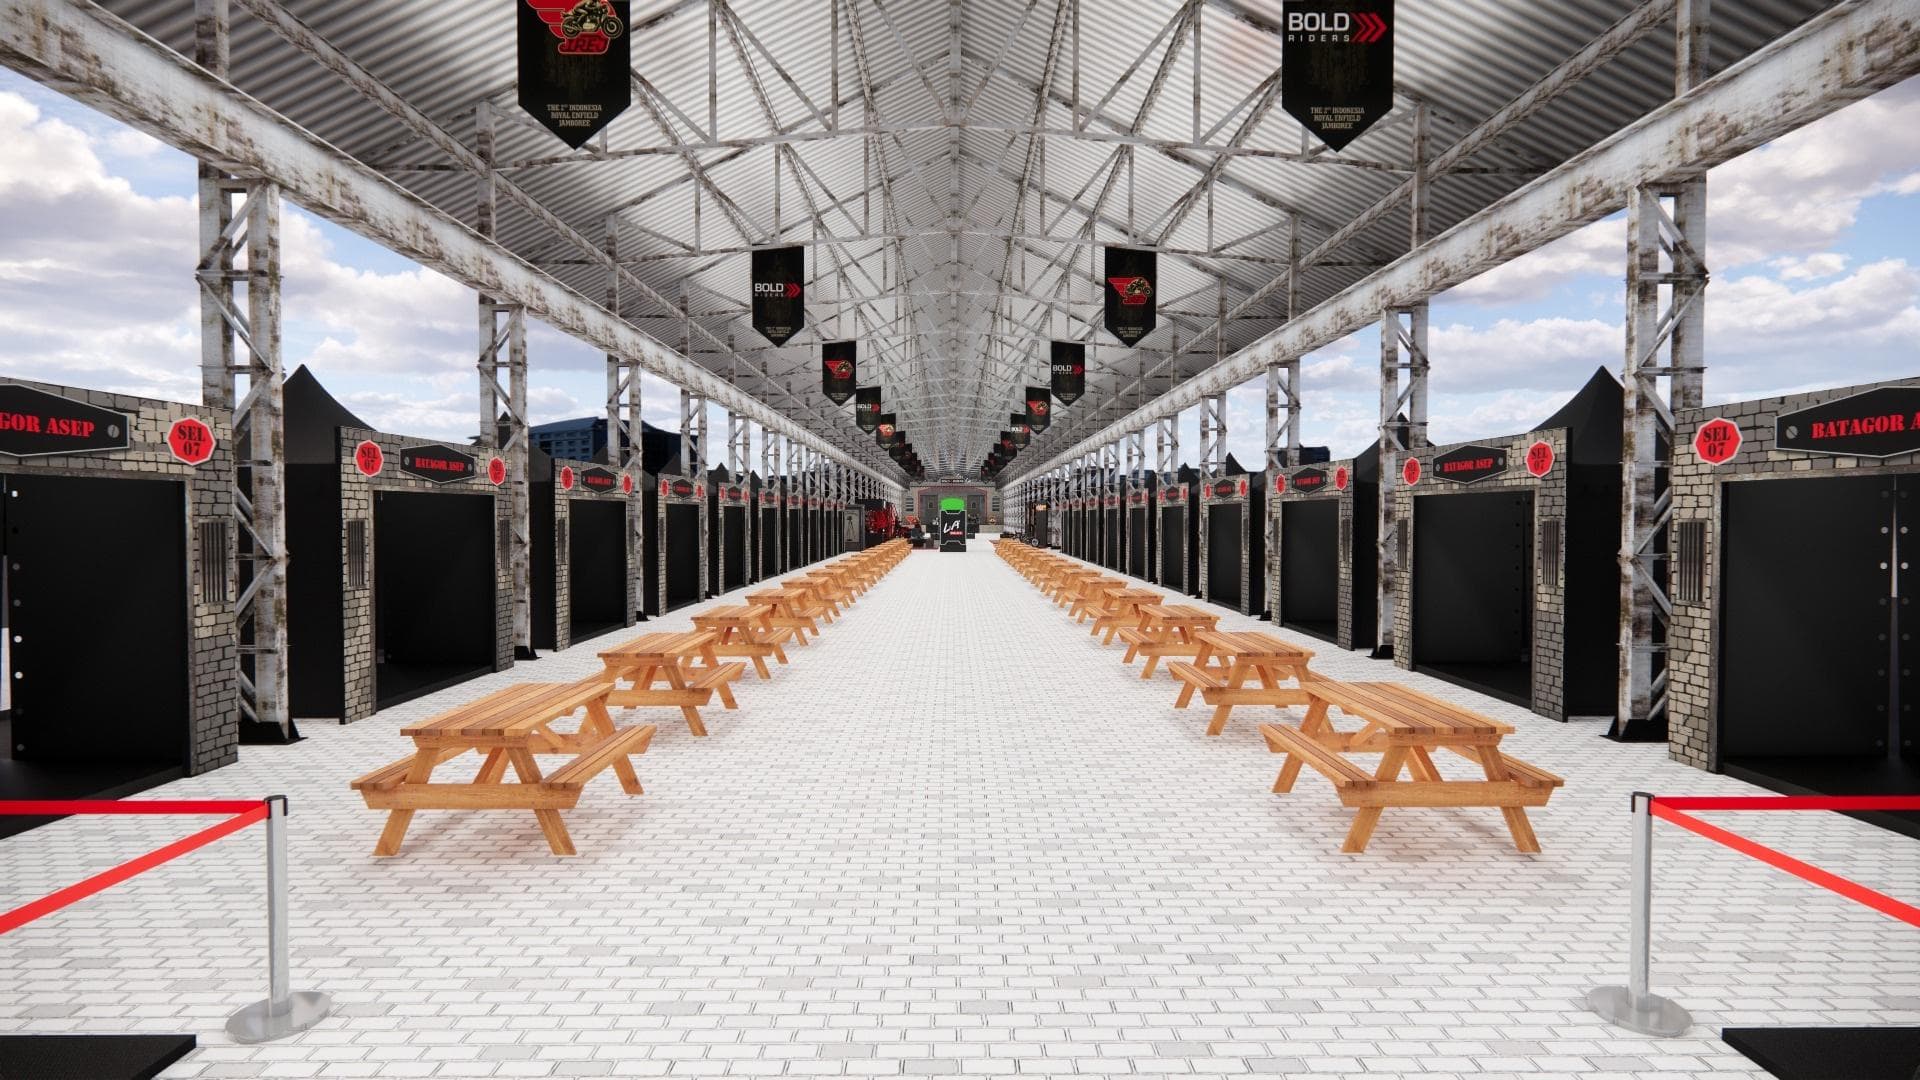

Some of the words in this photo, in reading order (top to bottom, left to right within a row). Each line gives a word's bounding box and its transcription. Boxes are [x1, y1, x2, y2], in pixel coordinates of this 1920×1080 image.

[1288, 12, 1350, 31] BOLD
[1288, 34, 1350, 42] RIDERS
[551, 111, 570, 119] ROYAL
[571, 111, 599, 119] ENFIELD
[559, 119, 591, 127] JAMBOREE
[754, 283, 784, 292] BOLD
[1052, 364, 1072, 372] BOLD
[0, 412, 40, 433] GOR
[46, 418, 95, 438] ASEP
[1811, 414, 1905, 439] BATAGOR
[177, 425, 206, 442] SEL
[1703, 426, 1731, 443] SEL
[182, 440, 201, 457] 07
[361, 447, 377, 459] SEL
[1531, 447, 1548, 459] SEL
[1707, 442, 1726, 457] 07
